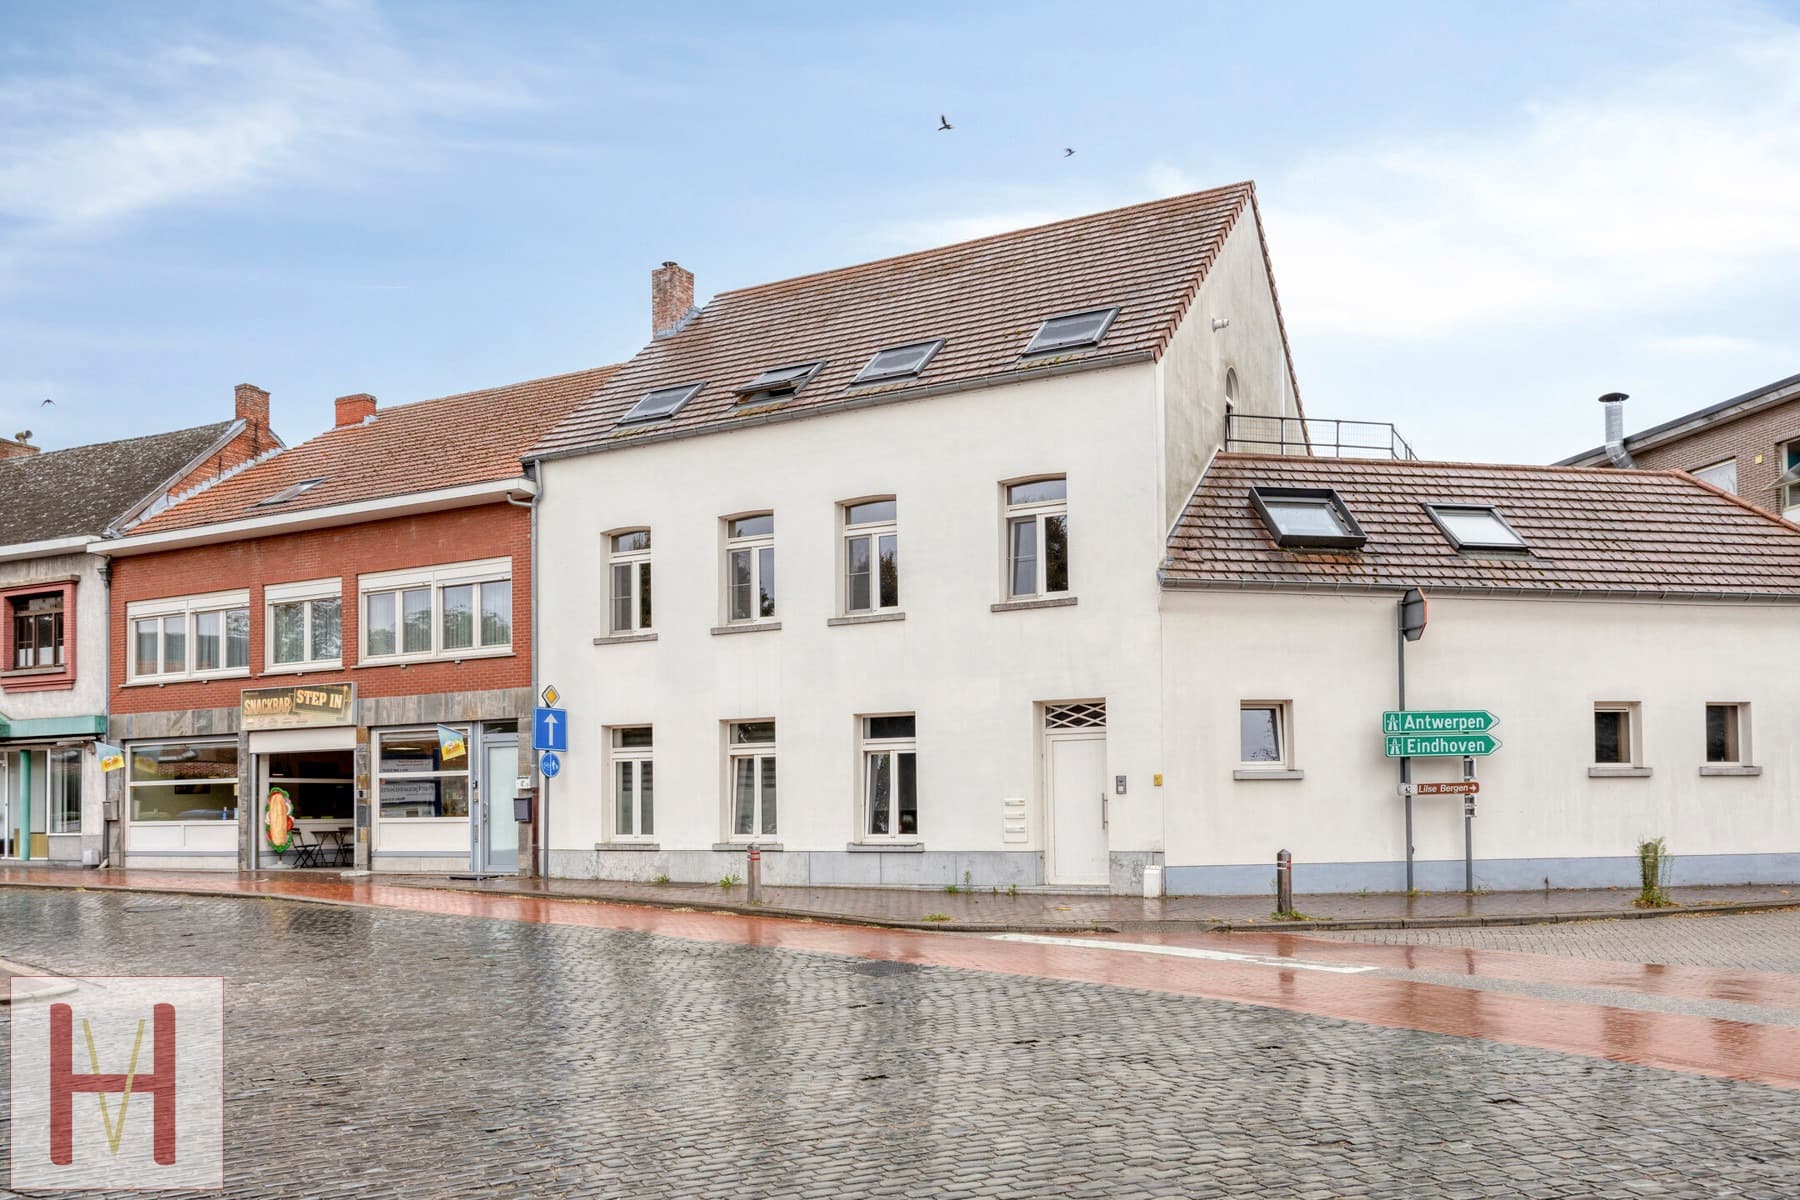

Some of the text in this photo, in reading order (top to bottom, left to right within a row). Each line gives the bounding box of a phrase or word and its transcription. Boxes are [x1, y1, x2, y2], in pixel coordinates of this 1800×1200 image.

[244, 690, 343, 714] SNACKBAR STEP IN
[1404, 714, 1485, 731] Antwerpen
[1407, 738, 1485, 753] Eindhoven
[1440, 783, 1469, 793] Bergen
